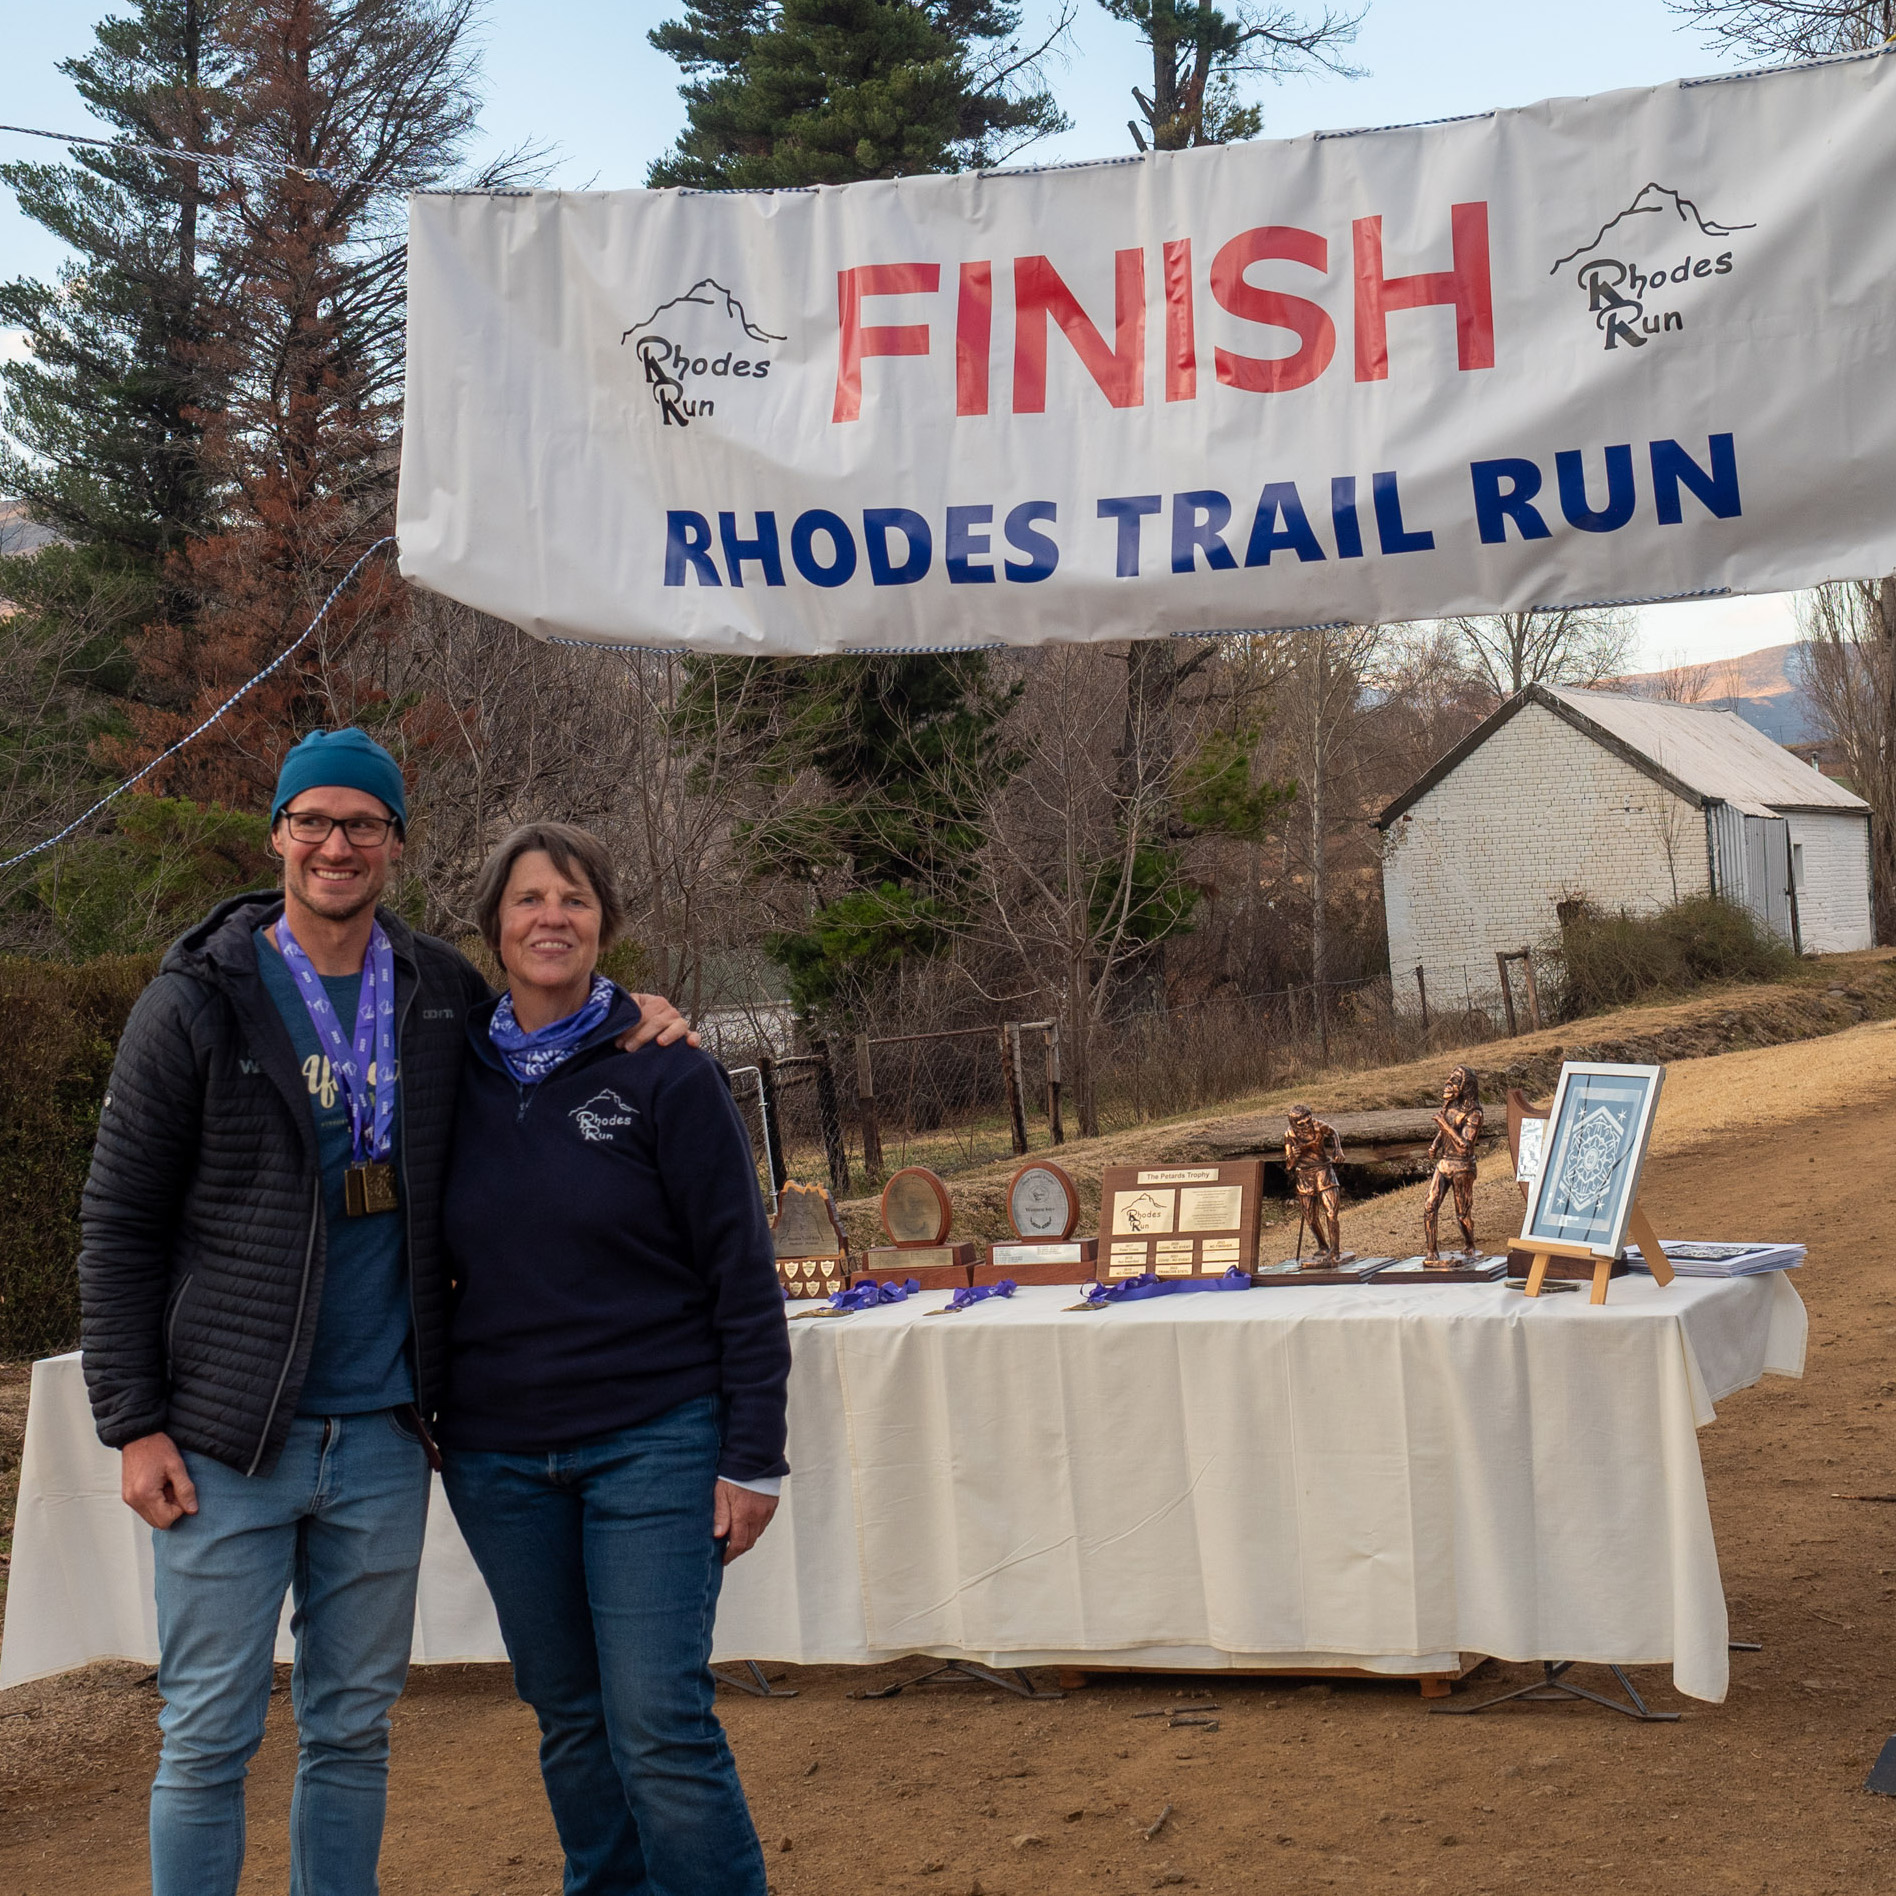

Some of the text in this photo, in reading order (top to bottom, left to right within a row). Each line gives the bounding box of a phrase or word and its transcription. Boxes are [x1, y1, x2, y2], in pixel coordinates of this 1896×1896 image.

[1577, 251, 1734, 312] Rhodes
[832, 201, 1495, 424] FINISH
[1596, 299, 1684, 351] Run
[636, 335, 771, 383] Rhodes
[652, 377, 715, 428] Run
[663, 432, 1743, 589] RHODES TRAIL RUN
[576, 1111, 632, 1129] Rhodes
[582, 1126, 614, 1142] Run
[1187, 1171, 1210, 1179] Trophy
[1126, 1209, 1162, 1222] Rhodes
[1130, 1220, 1150, 1232] Run
